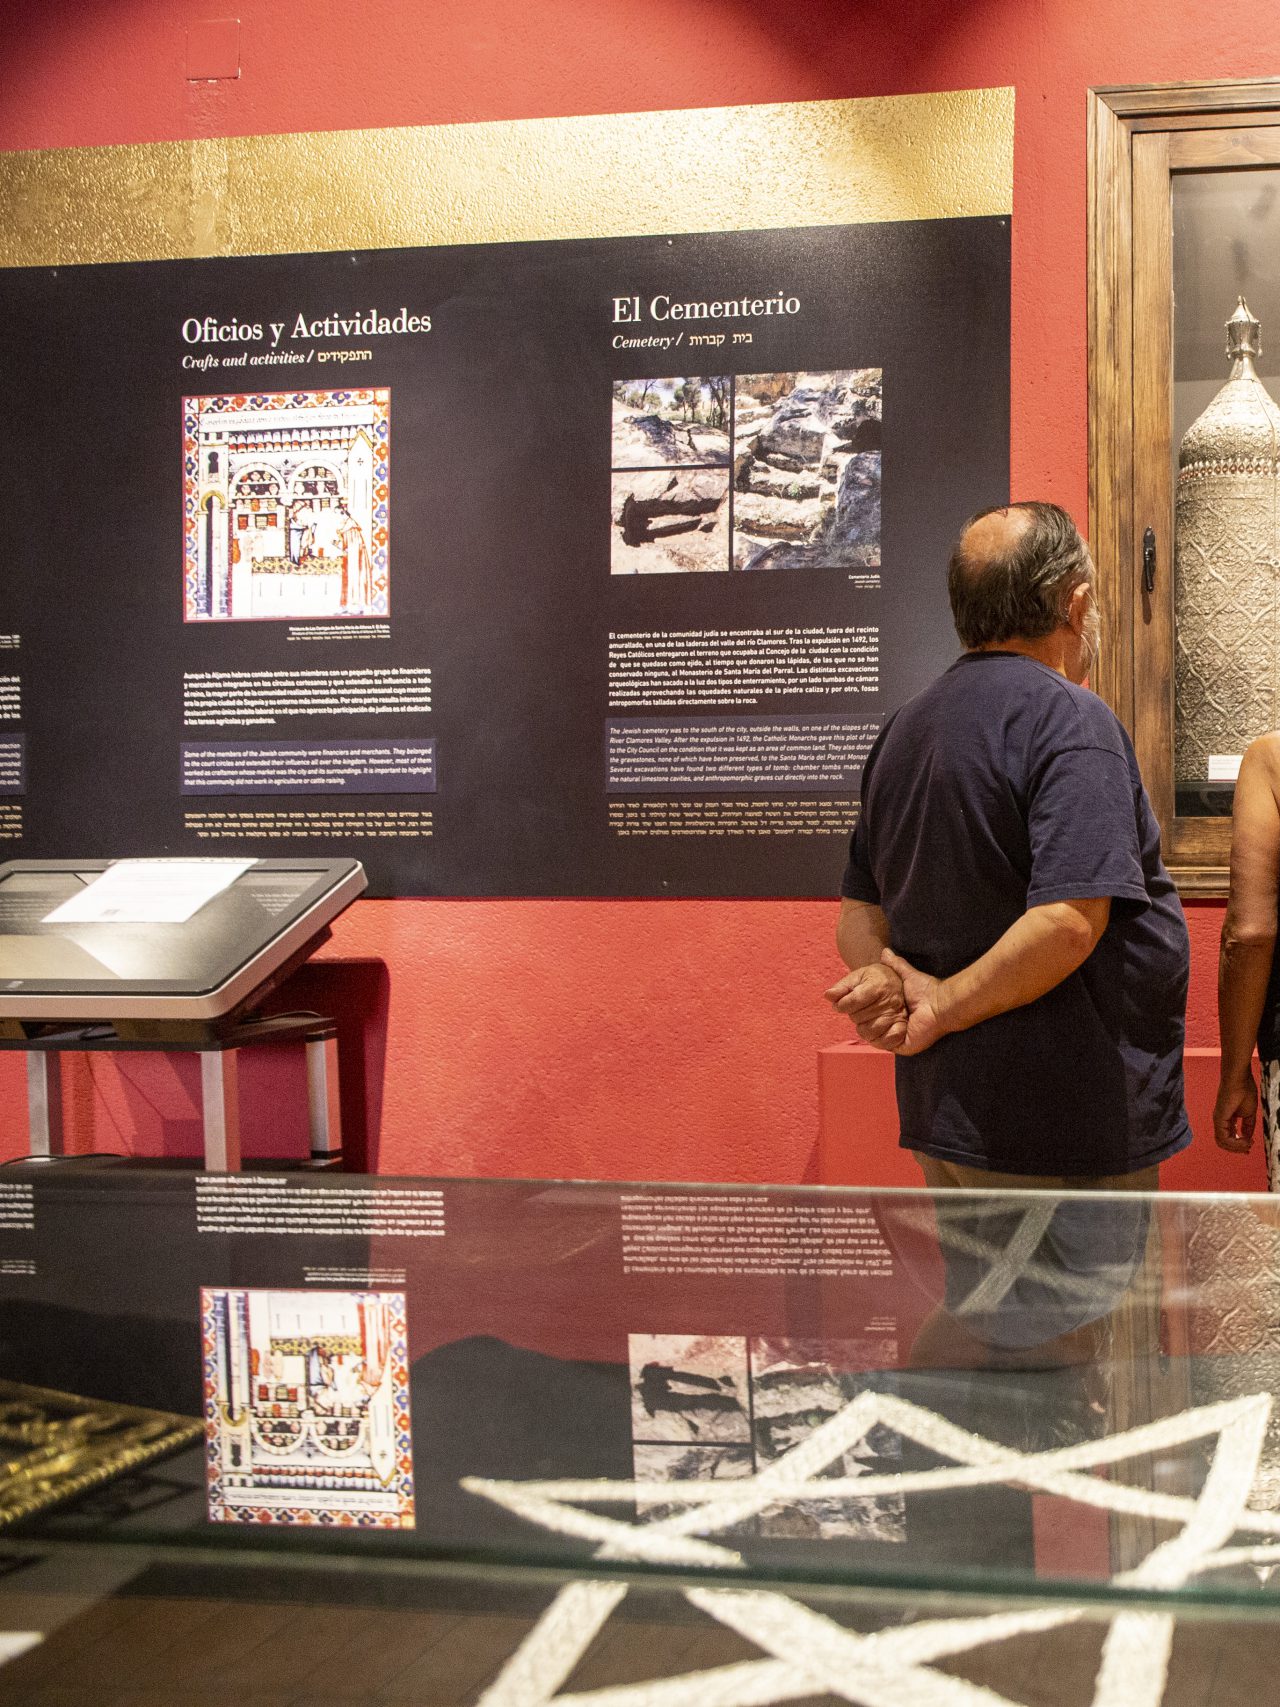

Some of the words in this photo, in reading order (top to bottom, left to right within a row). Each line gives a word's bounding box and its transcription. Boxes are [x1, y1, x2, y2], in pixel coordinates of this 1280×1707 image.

[612, 297, 641, 323] El
[650, 291, 800, 320] Cementerio
[182, 317, 263, 343] Oficios
[270, 324, 284, 347] y
[290, 308, 432, 339] Actividades
[612, 335, 674, 350] Cemetery
[689, 334, 725, 347] קברות
[732, 333, 752, 344] בית
[182, 354, 219, 372] Crafts
[222, 352, 247, 366] and
[250, 351, 305, 365] activities
[317, 350, 372, 364] התפקידים
[661, 630, 667, 638] la
[668, 630, 702, 638] comunidad
[703, 629, 718, 639] judía
[764, 628, 771, 636] al
[784, 628, 793, 636] de
[794, 628, 801, 636] la
[802, 627, 824, 637] ciudad,
[826, 627, 843, 635] fuera
[844, 627, 855, 635] del
[856, 626, 879, 634] recinto
[685, 639, 708, 647] laderas
[709, 639, 719, 647] del
[735, 638, 745, 646] del
[746, 638, 755, 646] río
[756, 638, 787, 646] Clamores.
[789, 637, 803, 645] Tras
[804, 637, 810, 645] la
[811, 637, 841, 647] expulsión
[868, 636, 878, 644] los
[608, 650, 626, 660] Reyes
[627, 650, 654, 658] Católicos
[689, 649, 695, 657] el
[696, 649, 719, 657] terreno
[719, 650, 731, 658] que
[732, 648, 757, 658] ocupaba
[765, 647, 789, 657] Concejo
[790, 647, 798, 655] de
[799, 647, 806, 655] la
[808, 647, 828, 655] ciudad
[842, 646, 848, 654] la
[849, 646, 878, 654] condición
[608, 660, 616, 668] de
[619, 662, 631, 670] que
[641, 660, 667, 670] quedase
[686, 659, 703, 669] ejido,
[712, 658, 734, 668] tiempo
[735, 660, 747, 668] que
[748, 658, 774, 666] donaron
[775, 657, 785, 665] las
[786, 657, 811, 667] lápidas,
[822, 656, 832, 664] las
[833, 658, 846, 666] que
[644, 669, 670, 679] ninguna,
[671, 669, 677, 677] al
[714, 668, 722, 676] de
[723, 668, 741, 676] Santa
[761, 667, 771, 675] del
[773, 667, 794, 675] Parral.
[796, 667, 808, 675] Las
[809, 666, 836, 674] distintas
